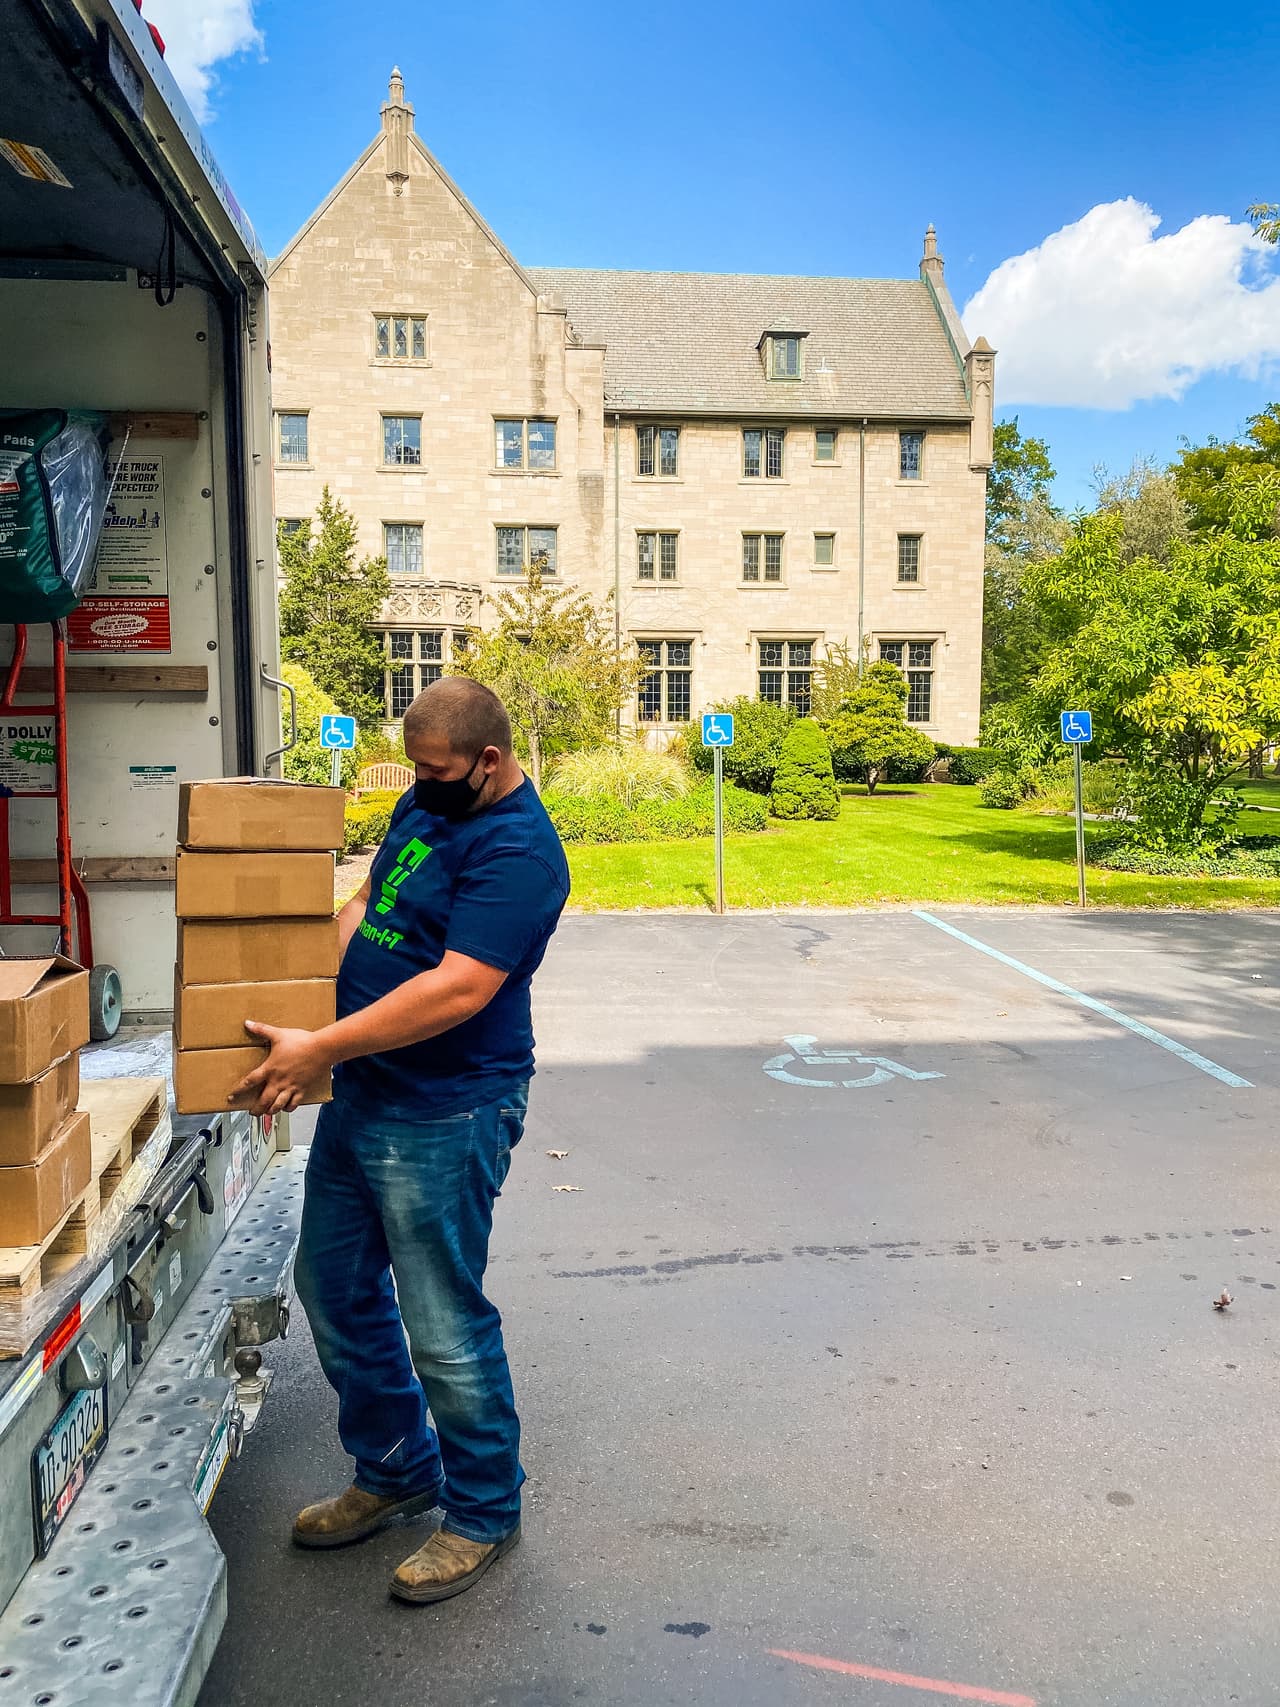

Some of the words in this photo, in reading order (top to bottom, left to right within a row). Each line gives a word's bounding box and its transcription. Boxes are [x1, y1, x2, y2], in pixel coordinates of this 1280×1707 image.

[3, 434, 35, 447] Pads
[130, 462, 160, 472] TRUCK
[130, 473, 157, 482] WORK
[111, 483, 160, 492] EXPECTED?
[7, 726, 52, 739] DOLLY
